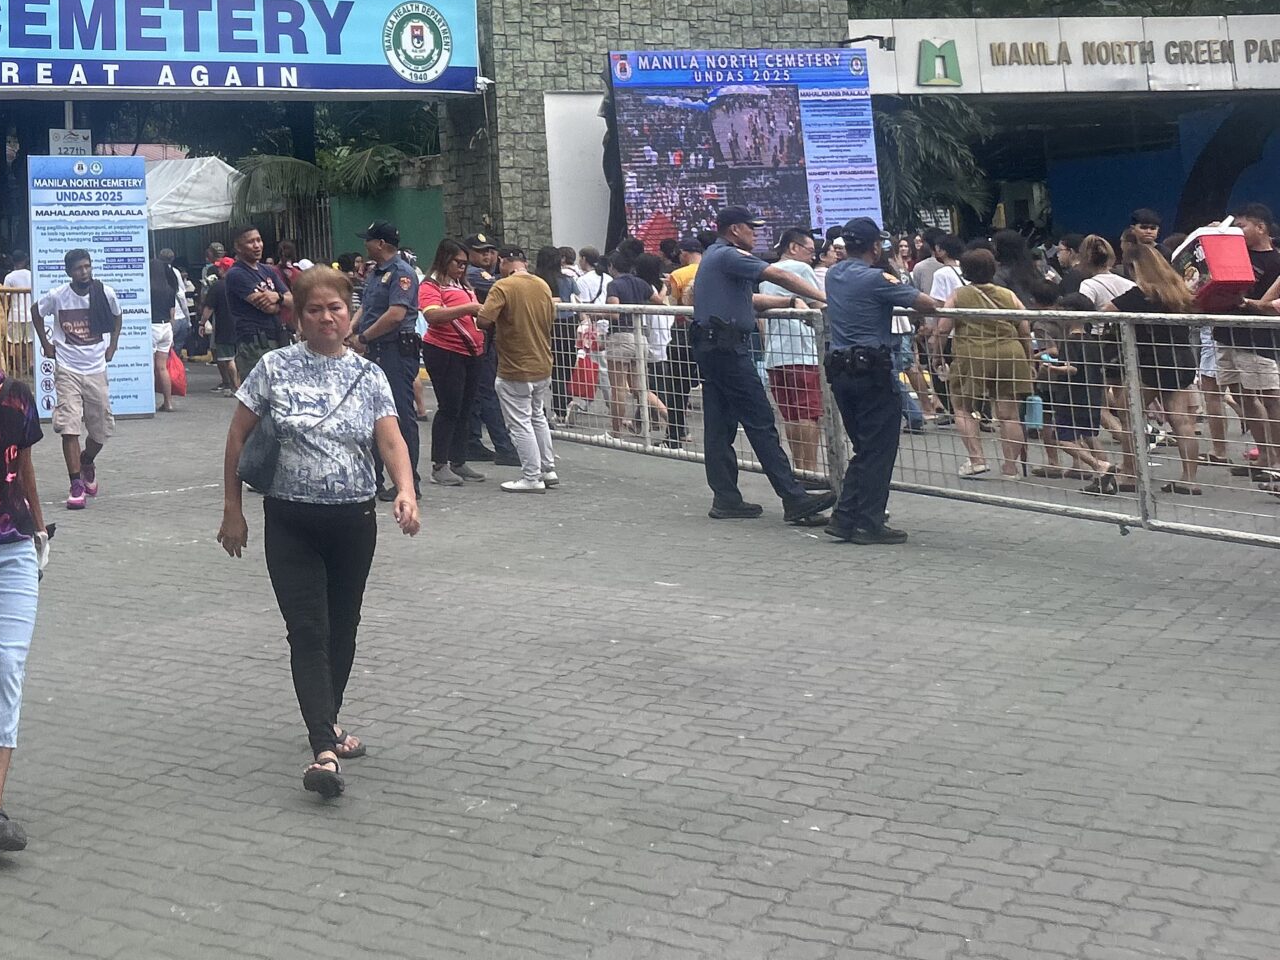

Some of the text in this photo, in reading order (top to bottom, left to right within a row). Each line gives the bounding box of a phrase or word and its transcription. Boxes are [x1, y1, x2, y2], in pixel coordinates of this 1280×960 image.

[385, 4, 450, 52] MANILA HEALTH DEPARTMENT
[989, 39, 1280, 66] MANILA NORTH GREEN PAR
[638, 53, 841, 70] MANILA NORTH CEMETERY
[160, 64, 300, 87] AGAIN
[409, 72, 428, 81] 1940
[694, 69, 791, 82] UNDAS 2025
[58, 146, 86, 155] 127th
[33, 178, 143, 187] MANILA NORTH CEMETERY
[56, 191, 123, 201] UNDAS 2025
